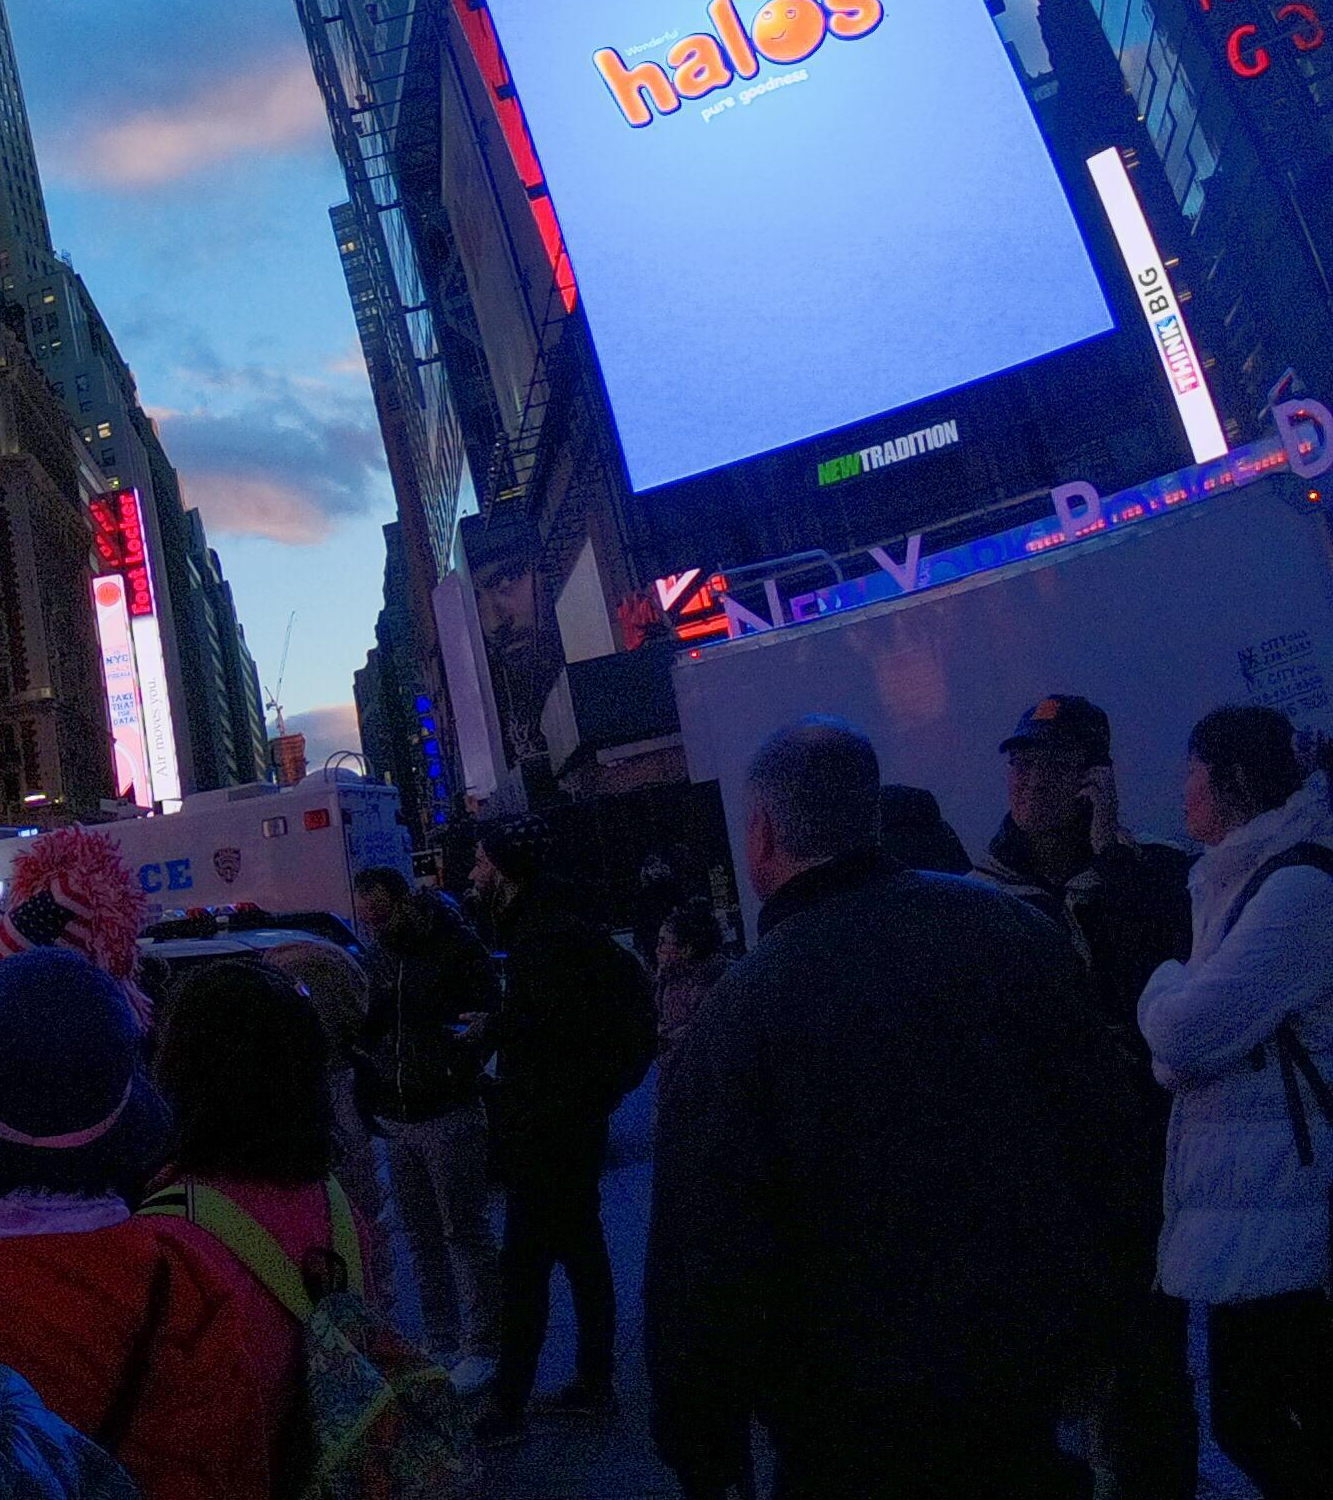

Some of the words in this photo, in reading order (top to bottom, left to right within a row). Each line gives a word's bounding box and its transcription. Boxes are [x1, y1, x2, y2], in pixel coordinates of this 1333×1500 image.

[701, 96, 736, 123] pure
[739, 69, 810, 105] goodness
[1136, 266, 1171, 316] BIG
[1153, 315, 1201, 394] THINK
[151, 707, 166, 747] moves
[156, 751, 168, 776] Air
